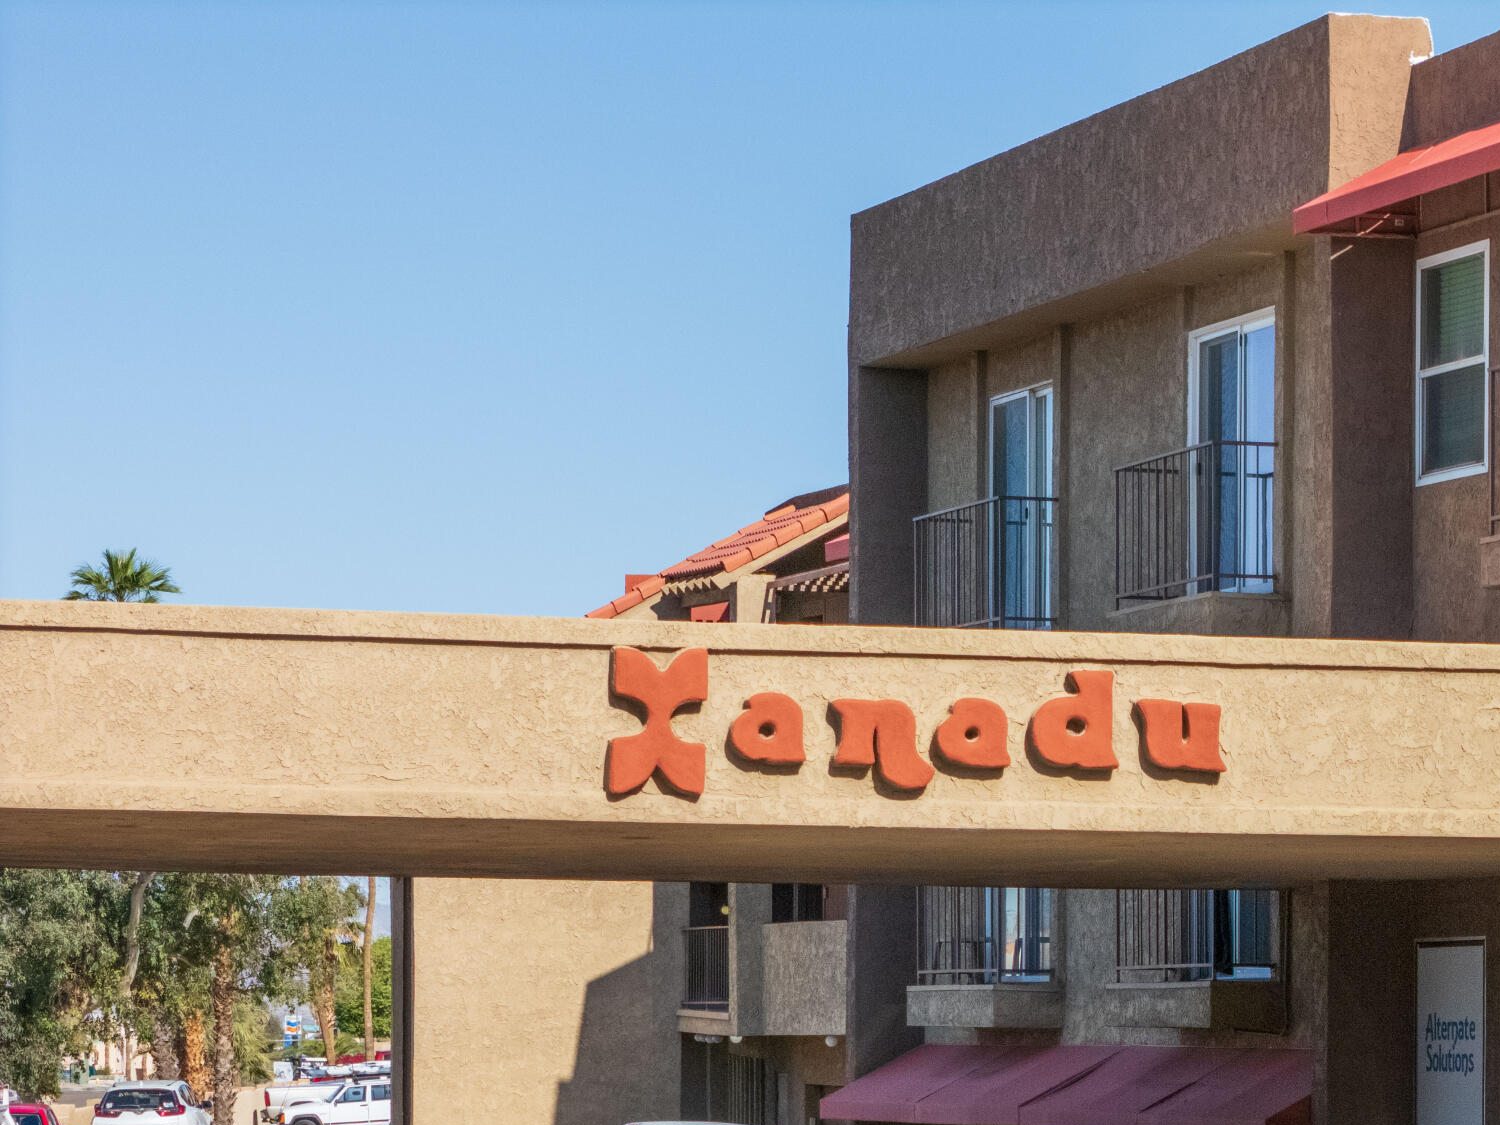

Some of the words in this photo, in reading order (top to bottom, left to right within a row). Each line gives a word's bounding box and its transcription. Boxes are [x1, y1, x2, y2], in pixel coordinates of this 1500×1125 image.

[604, 646, 1227, 802] Xanadu
[1425, 1012, 1476, 1050] Alternate
[1425, 1044, 1475, 1077] Solutions
